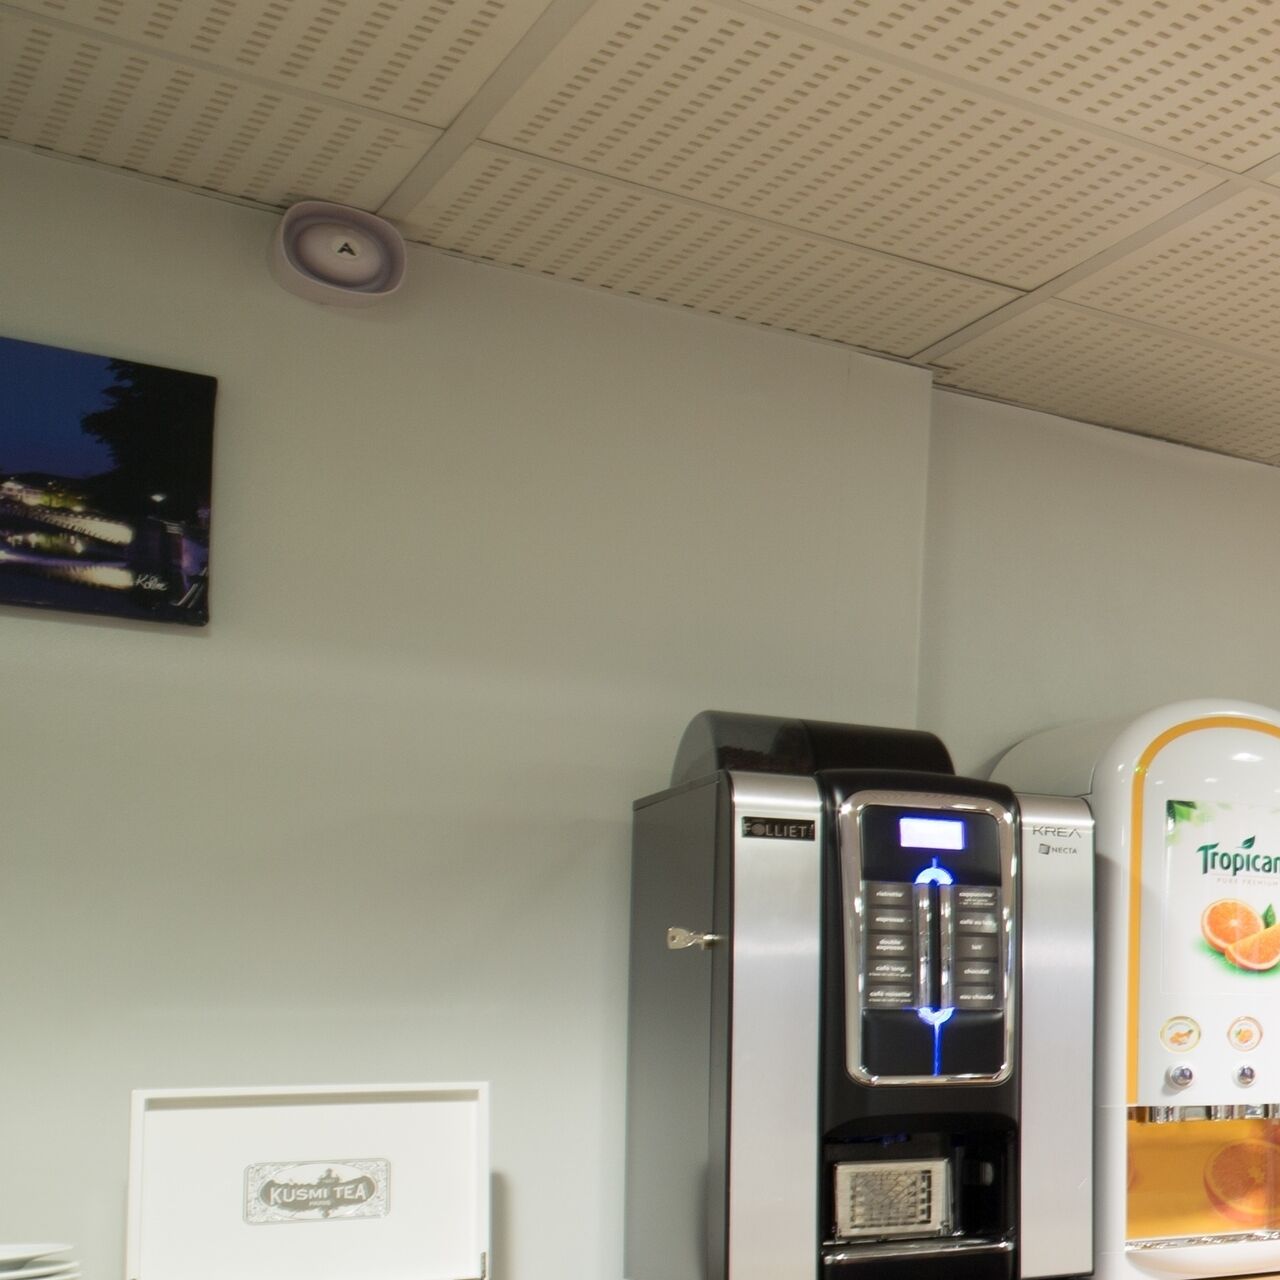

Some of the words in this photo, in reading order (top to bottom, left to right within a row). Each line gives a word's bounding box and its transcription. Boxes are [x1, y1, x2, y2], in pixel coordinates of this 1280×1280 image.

[1051, 847, 1078, 855] NECTA
[270, 1187, 329, 1205] KUSMI
[333, 1182, 367, 1200] TEA
